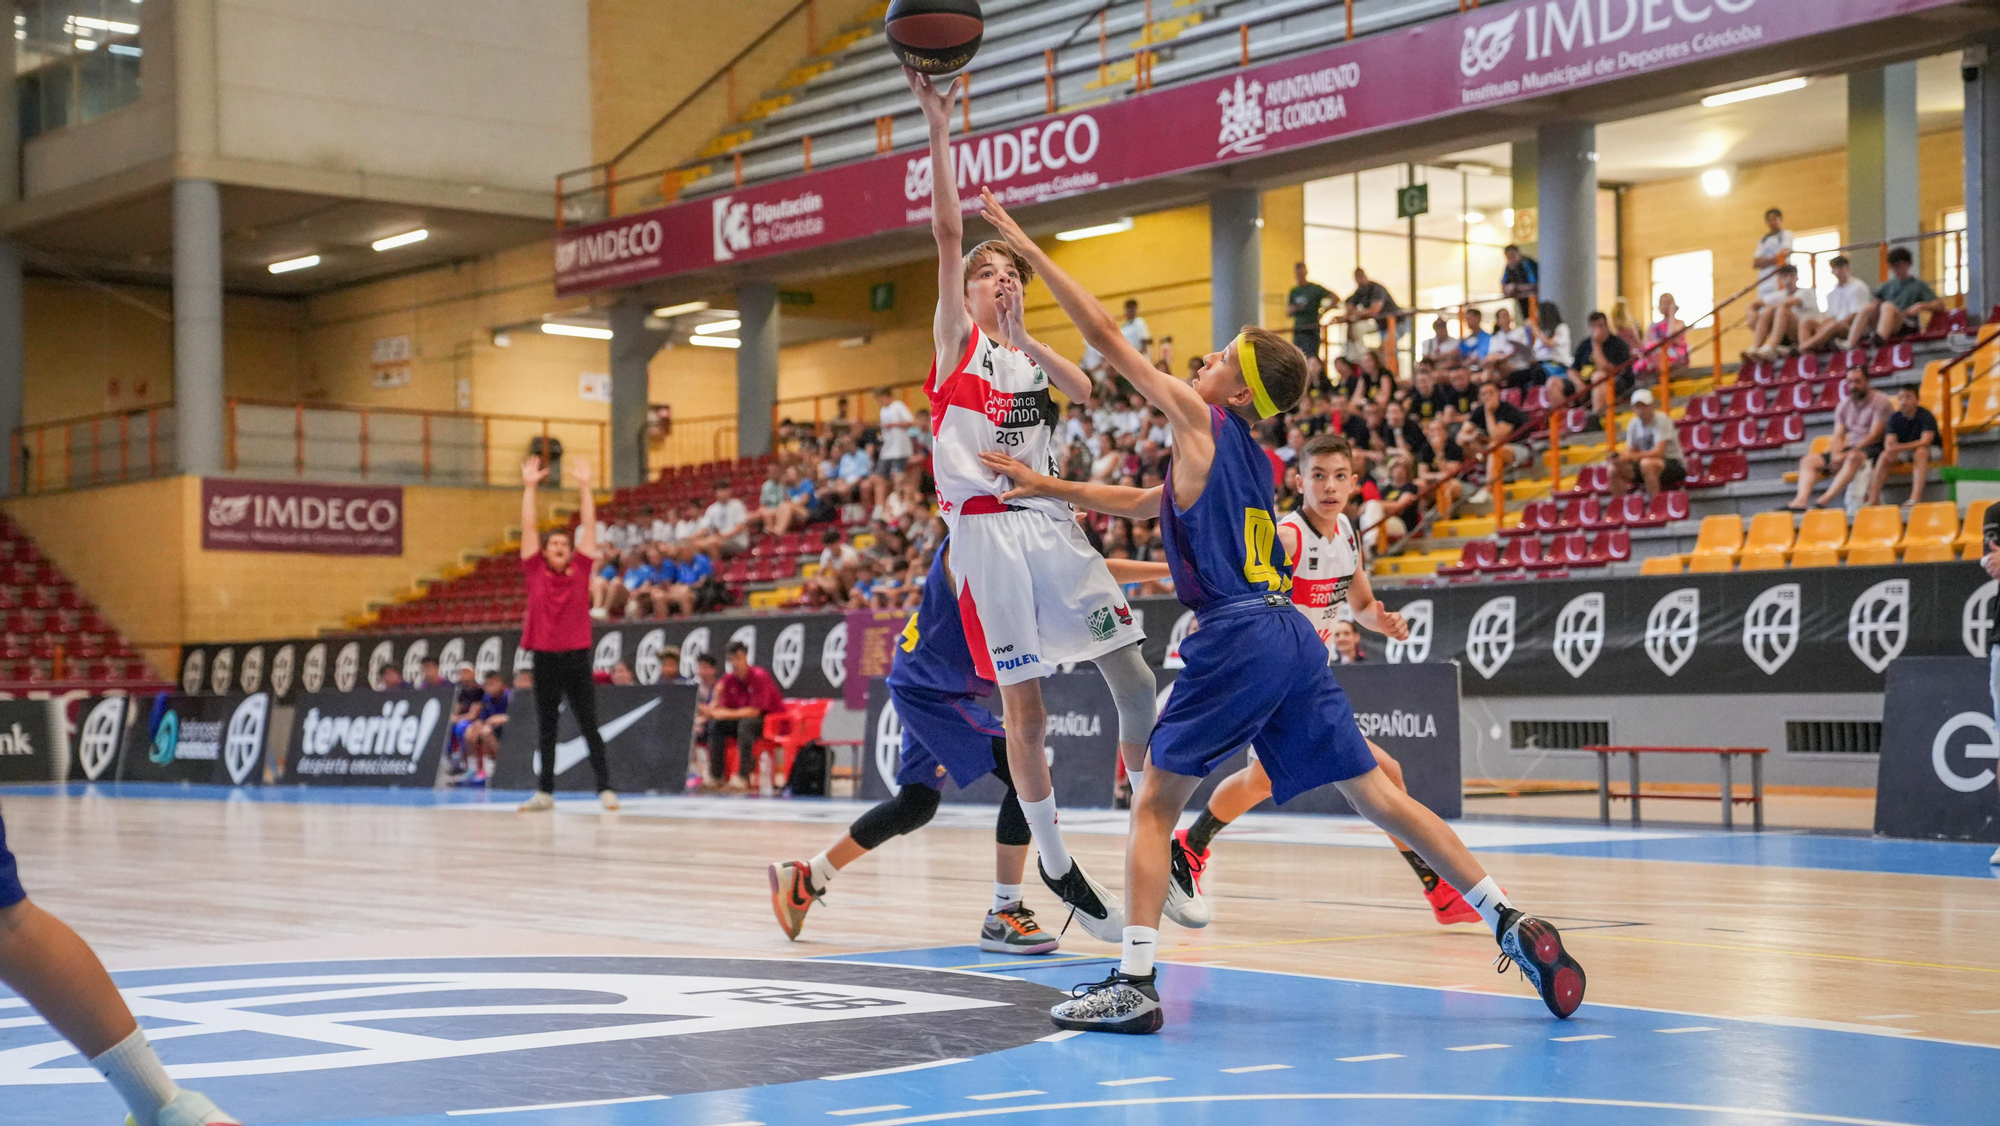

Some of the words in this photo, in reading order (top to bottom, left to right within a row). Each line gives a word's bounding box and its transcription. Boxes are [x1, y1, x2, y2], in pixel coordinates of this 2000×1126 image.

[1525, 0, 1755, 61] IMDE
[1264, 62, 1361, 107] AYUNTAMIENTO
[1521, 63, 1592, 91] Municipal
[1594, 55, 1616, 76] de
[1617, 41, 1689, 71] Deportes
[1265, 107, 1283, 134] DE
[578, 219, 663, 267] IMDECO
[254, 494, 399, 532] IMDECO
[1046, 711, 1101, 737] PAÑOLA
